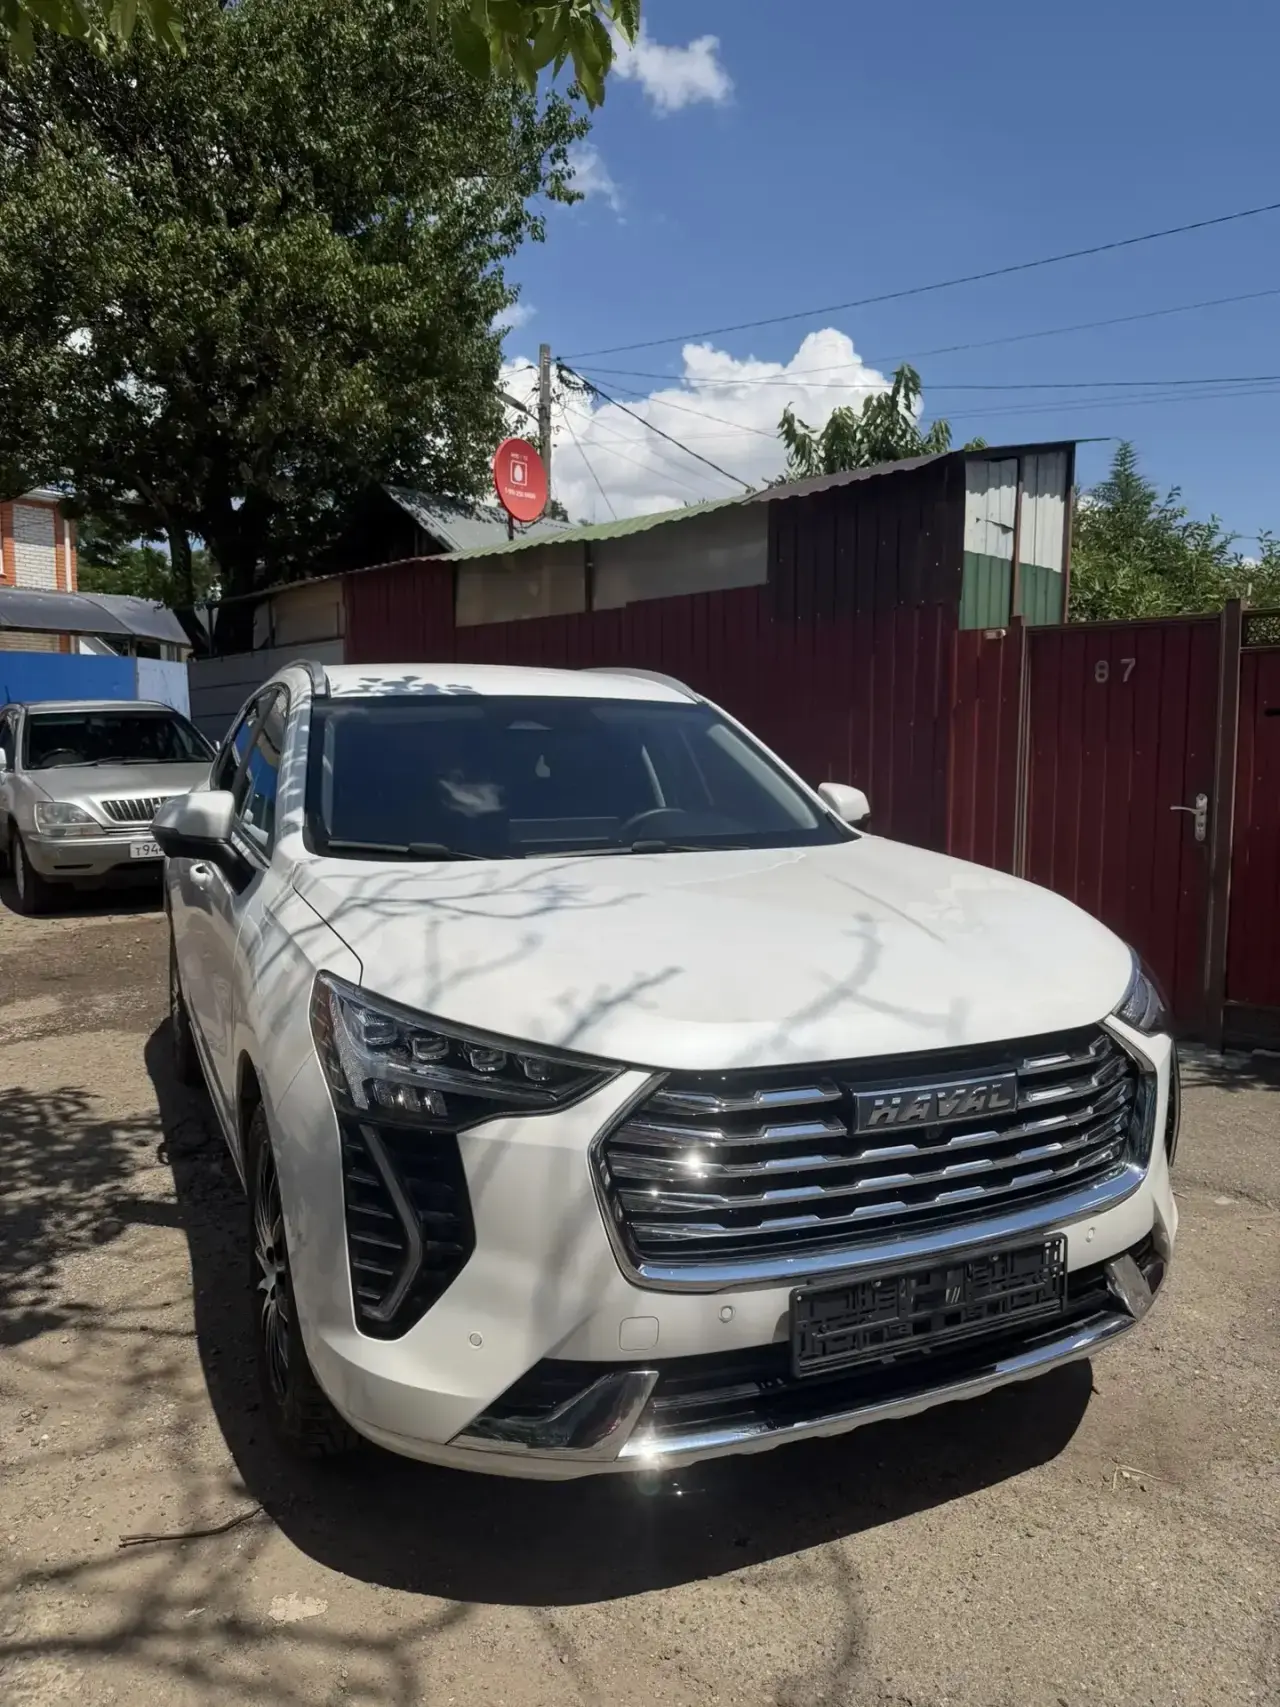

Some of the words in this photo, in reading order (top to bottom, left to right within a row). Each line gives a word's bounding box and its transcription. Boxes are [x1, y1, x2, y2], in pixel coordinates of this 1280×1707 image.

[1095, 658, 1136, 683] 87
[135, 843, 162, 856] Т94
[866, 1083, 1011, 1126] HAVAL
